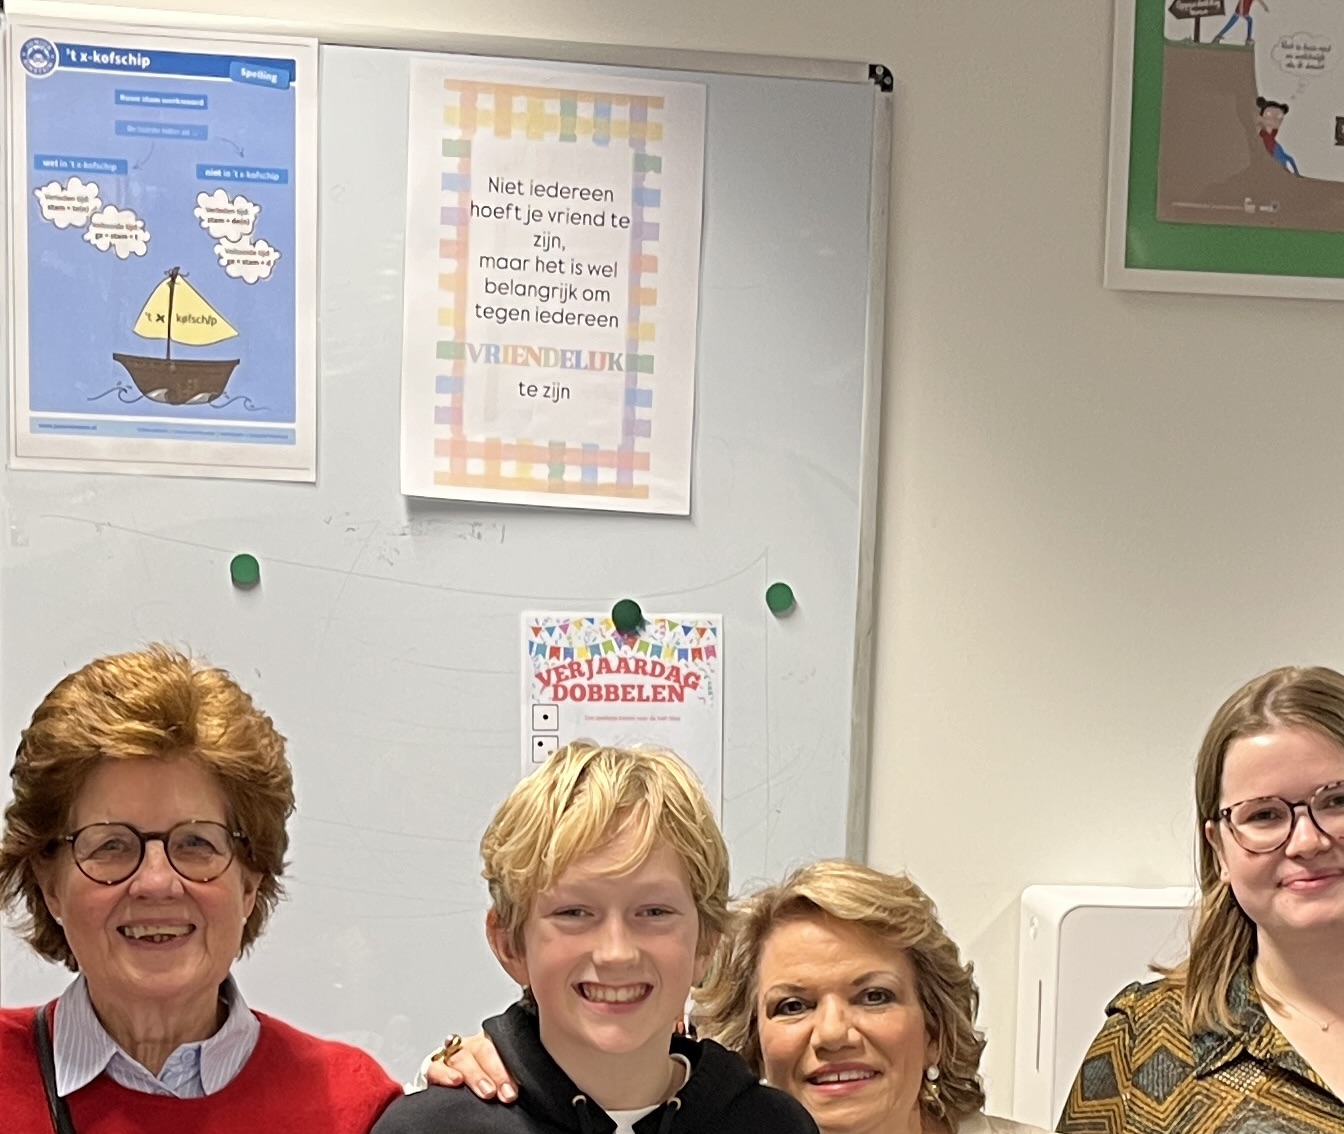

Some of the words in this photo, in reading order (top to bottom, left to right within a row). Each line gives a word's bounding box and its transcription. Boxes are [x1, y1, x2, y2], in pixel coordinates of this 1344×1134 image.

[65, 47, 77, 62] 't
[79, 49, 152, 69] x-kofschip
[240, 66, 278, 84] Spelling
[488, 176, 525, 196] Niet
[529, 178, 615, 203] iedereen
[470, 199, 522, 221] hoeft
[522, 204, 544, 226] je
[547, 207, 606, 228] vriend
[610, 212, 631, 229] te
[533, 231, 567, 252] zijn,
[479, 255, 531, 272] maar
[535, 256, 567, 275] het
[570, 258, 584, 276] is
[587, 261, 618, 278] wel
[484, 277, 578, 304] belangrijk
[582, 288, 611, 303] om
[475, 303, 531, 325] tegen
[535, 306, 620, 329] iedereen
[519, 381, 539, 397] te
[542, 382, 571, 404] zijn
[535, 656, 702, 691] VERJAARDAG
[550, 683, 686, 703] DOBBELEN
